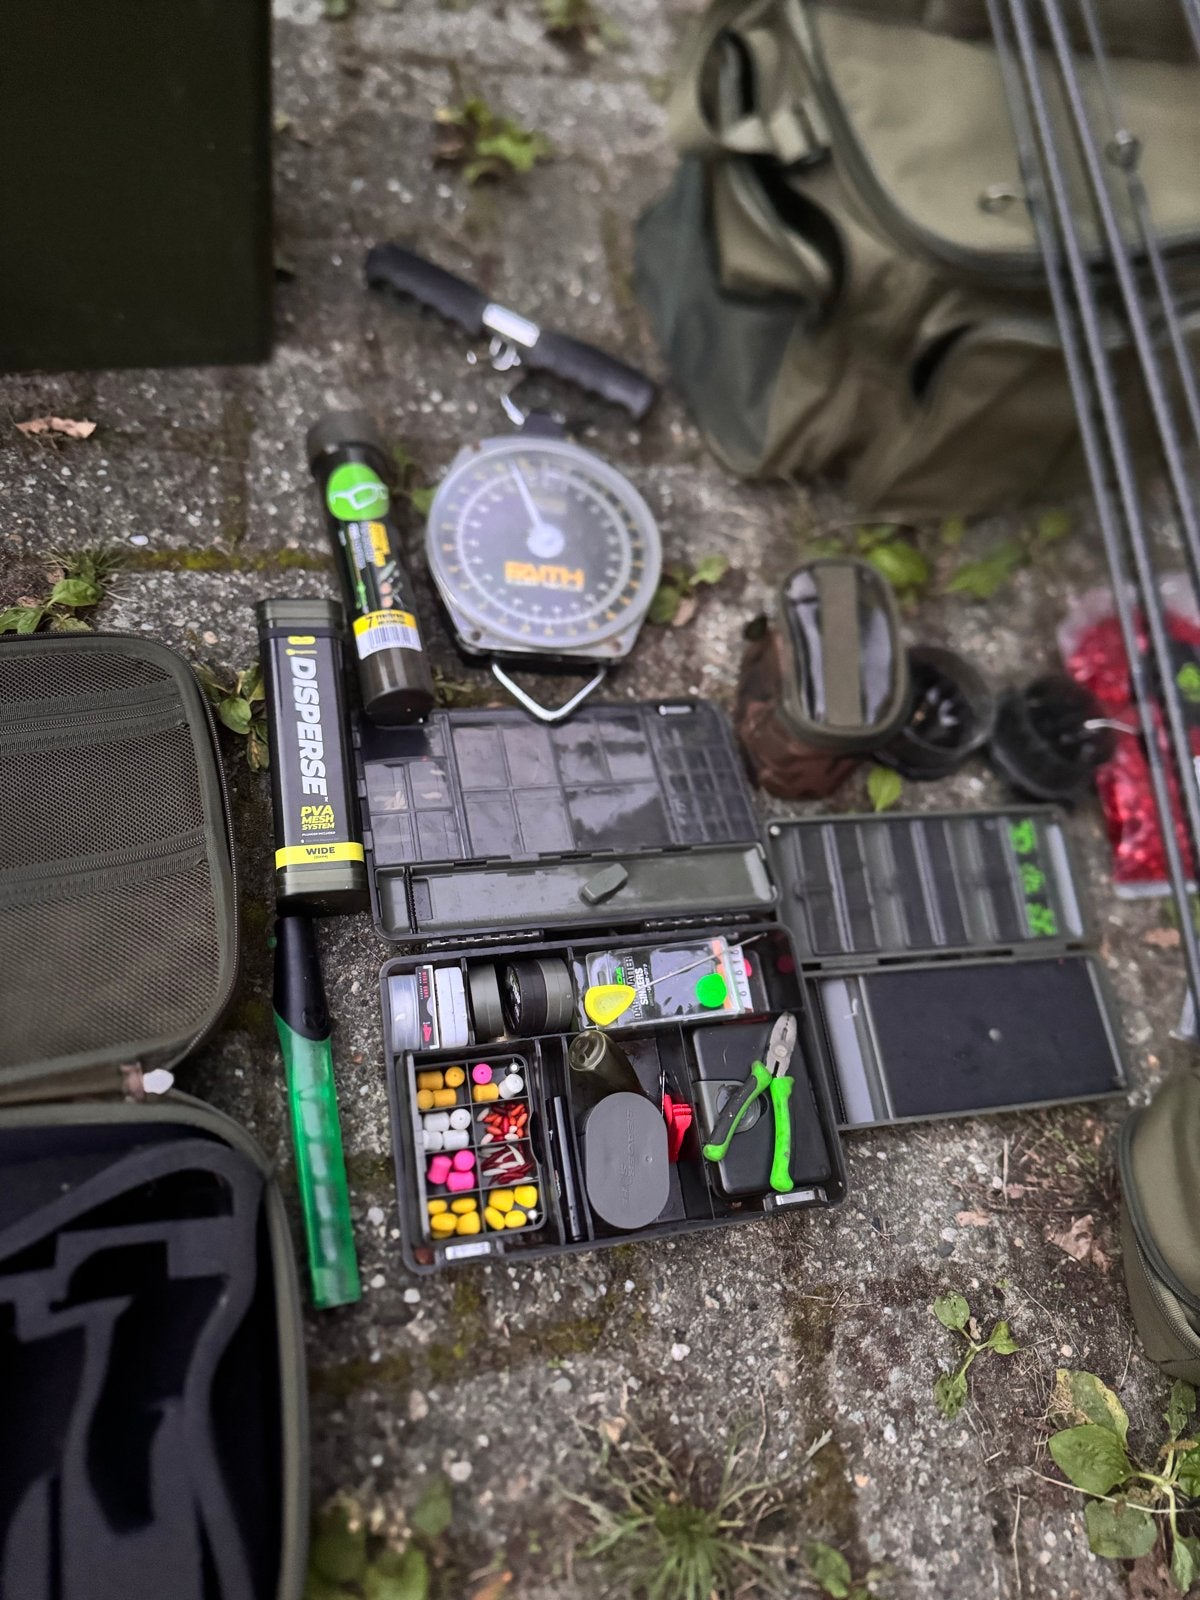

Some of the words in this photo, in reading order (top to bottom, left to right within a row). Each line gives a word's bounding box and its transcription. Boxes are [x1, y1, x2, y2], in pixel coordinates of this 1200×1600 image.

[290, 656, 328, 796] DISPERSE
[301, 804, 334, 817] PVA
[301, 814, 335, 824] MESH
[301, 822, 335, 831] SYSTEM
[306, 846, 336, 855] WIDE
